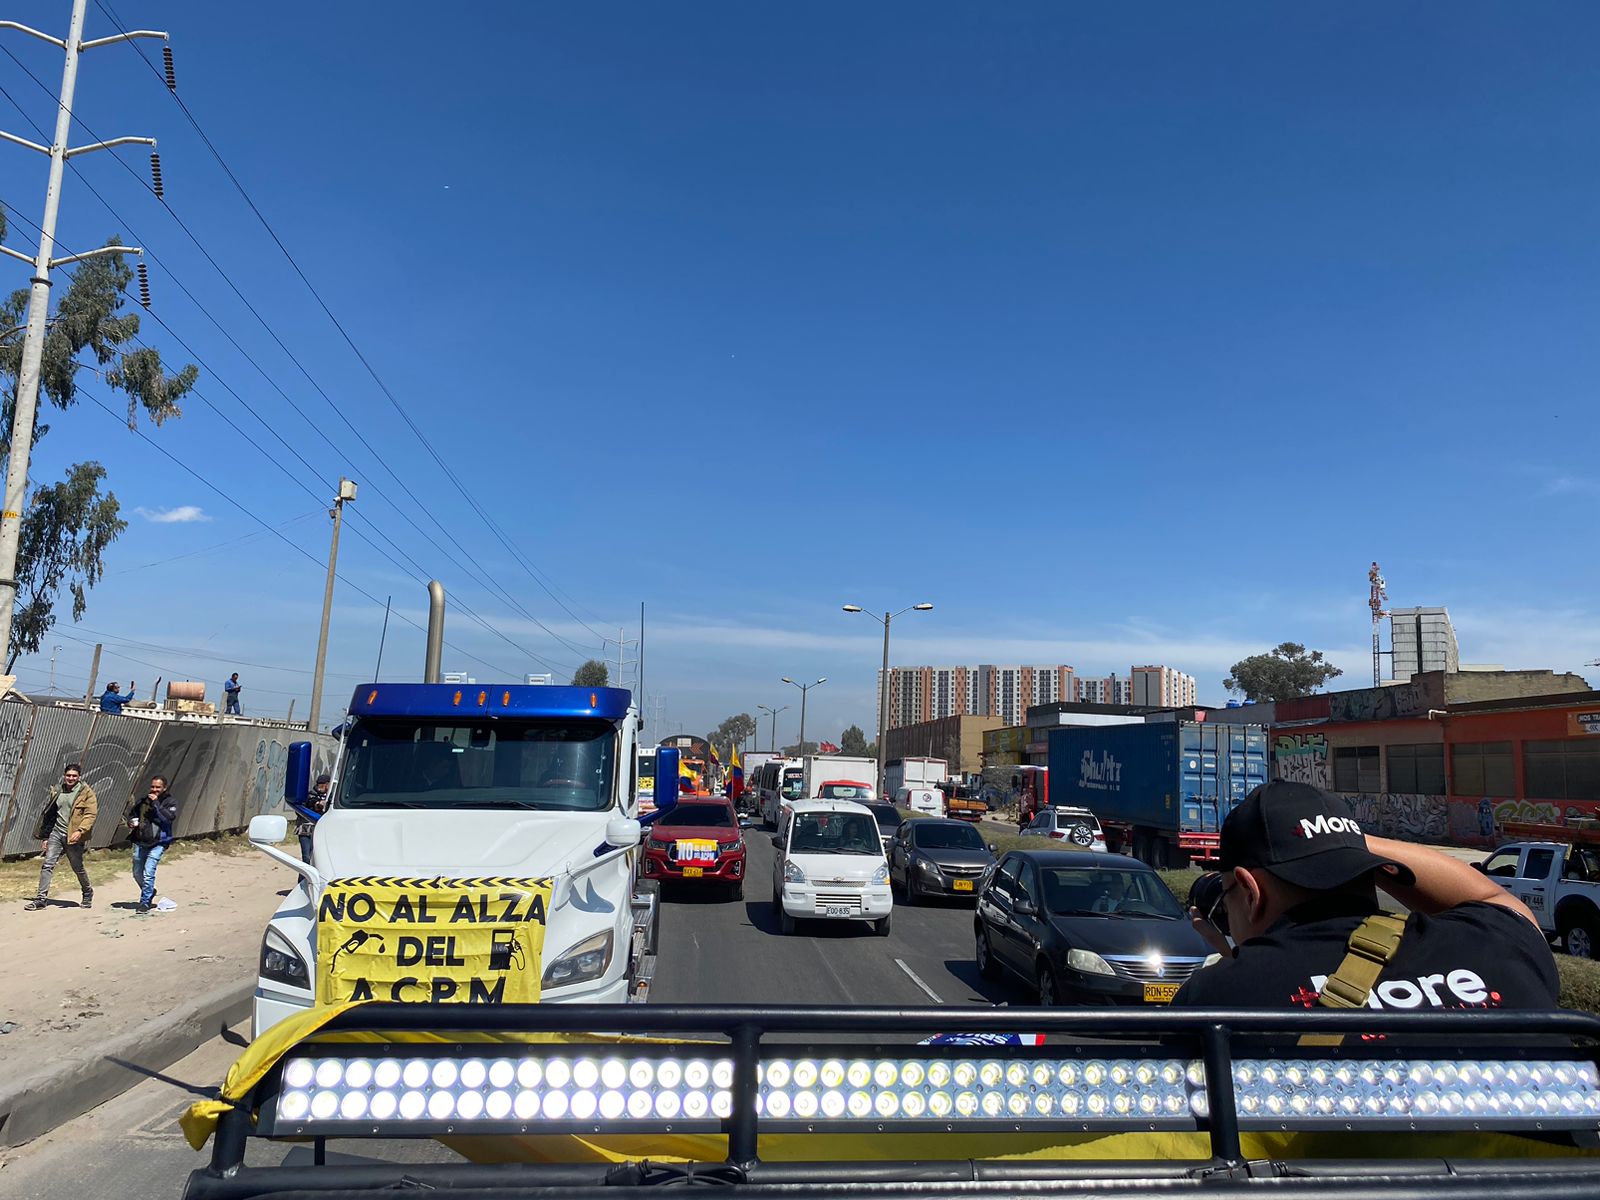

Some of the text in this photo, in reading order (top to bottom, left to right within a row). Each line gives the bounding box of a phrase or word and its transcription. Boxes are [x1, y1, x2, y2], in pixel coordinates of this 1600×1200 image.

[1299, 814, 1362, 839] More
[677, 841, 694, 861] NO
[318, 892, 547, 926] NO AL ALZA
[396, 936, 465, 967] DEL
